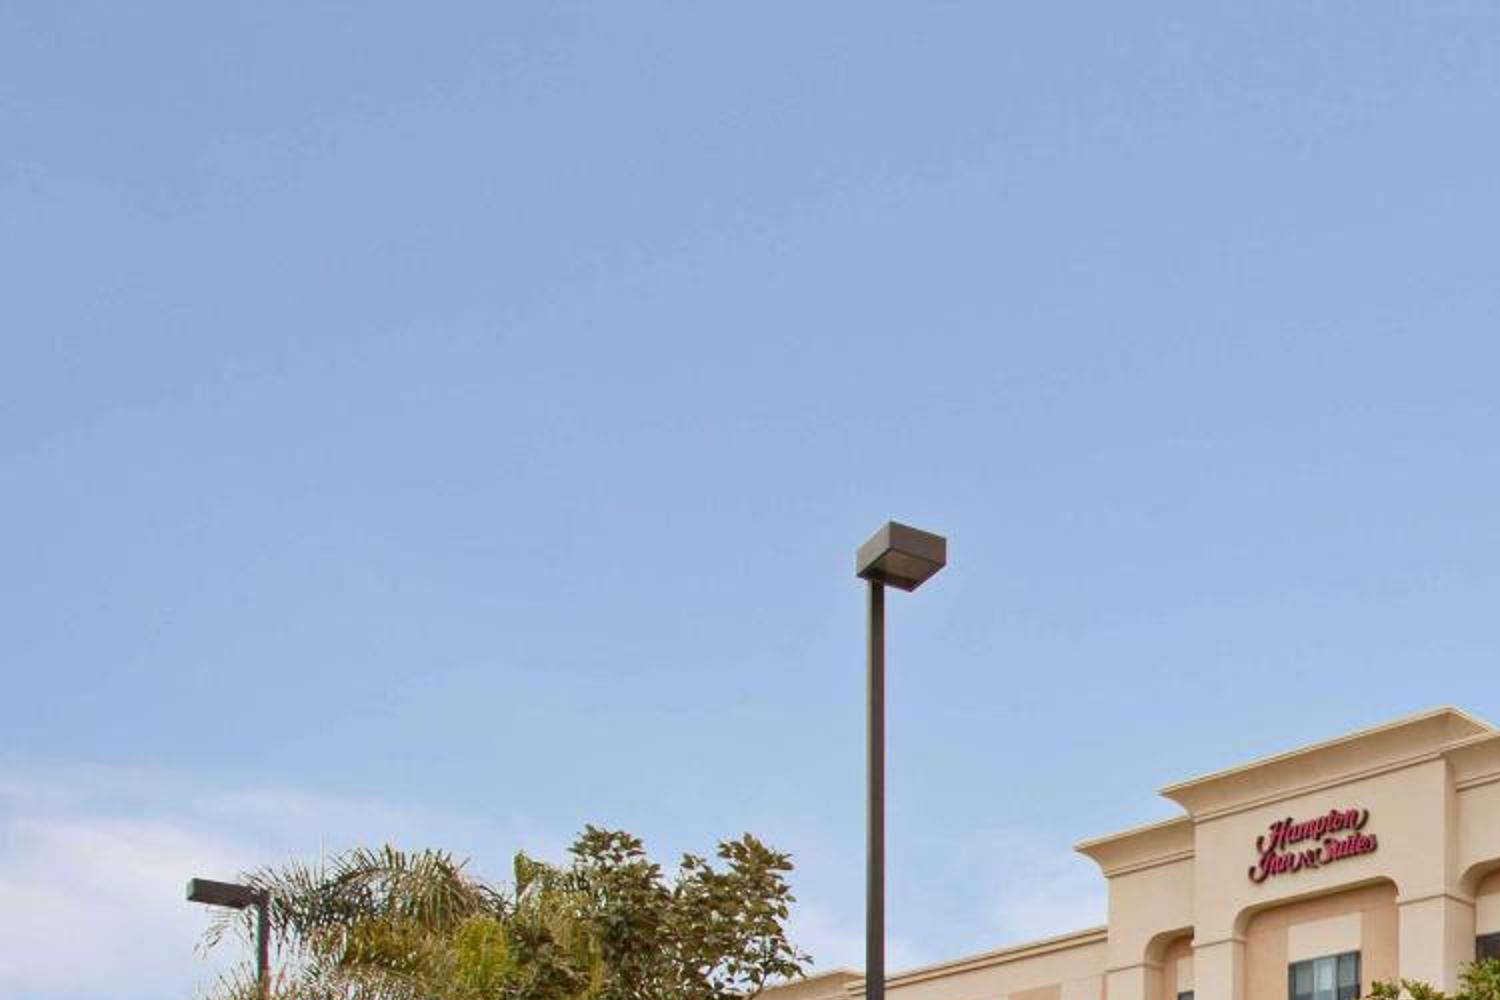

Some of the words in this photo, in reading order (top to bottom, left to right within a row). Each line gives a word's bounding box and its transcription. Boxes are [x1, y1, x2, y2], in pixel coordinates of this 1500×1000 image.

[1256, 808, 1369, 854] Hampton
[1248, 849, 1302, 883] Inn
[1319, 831, 1378, 865] Suites
